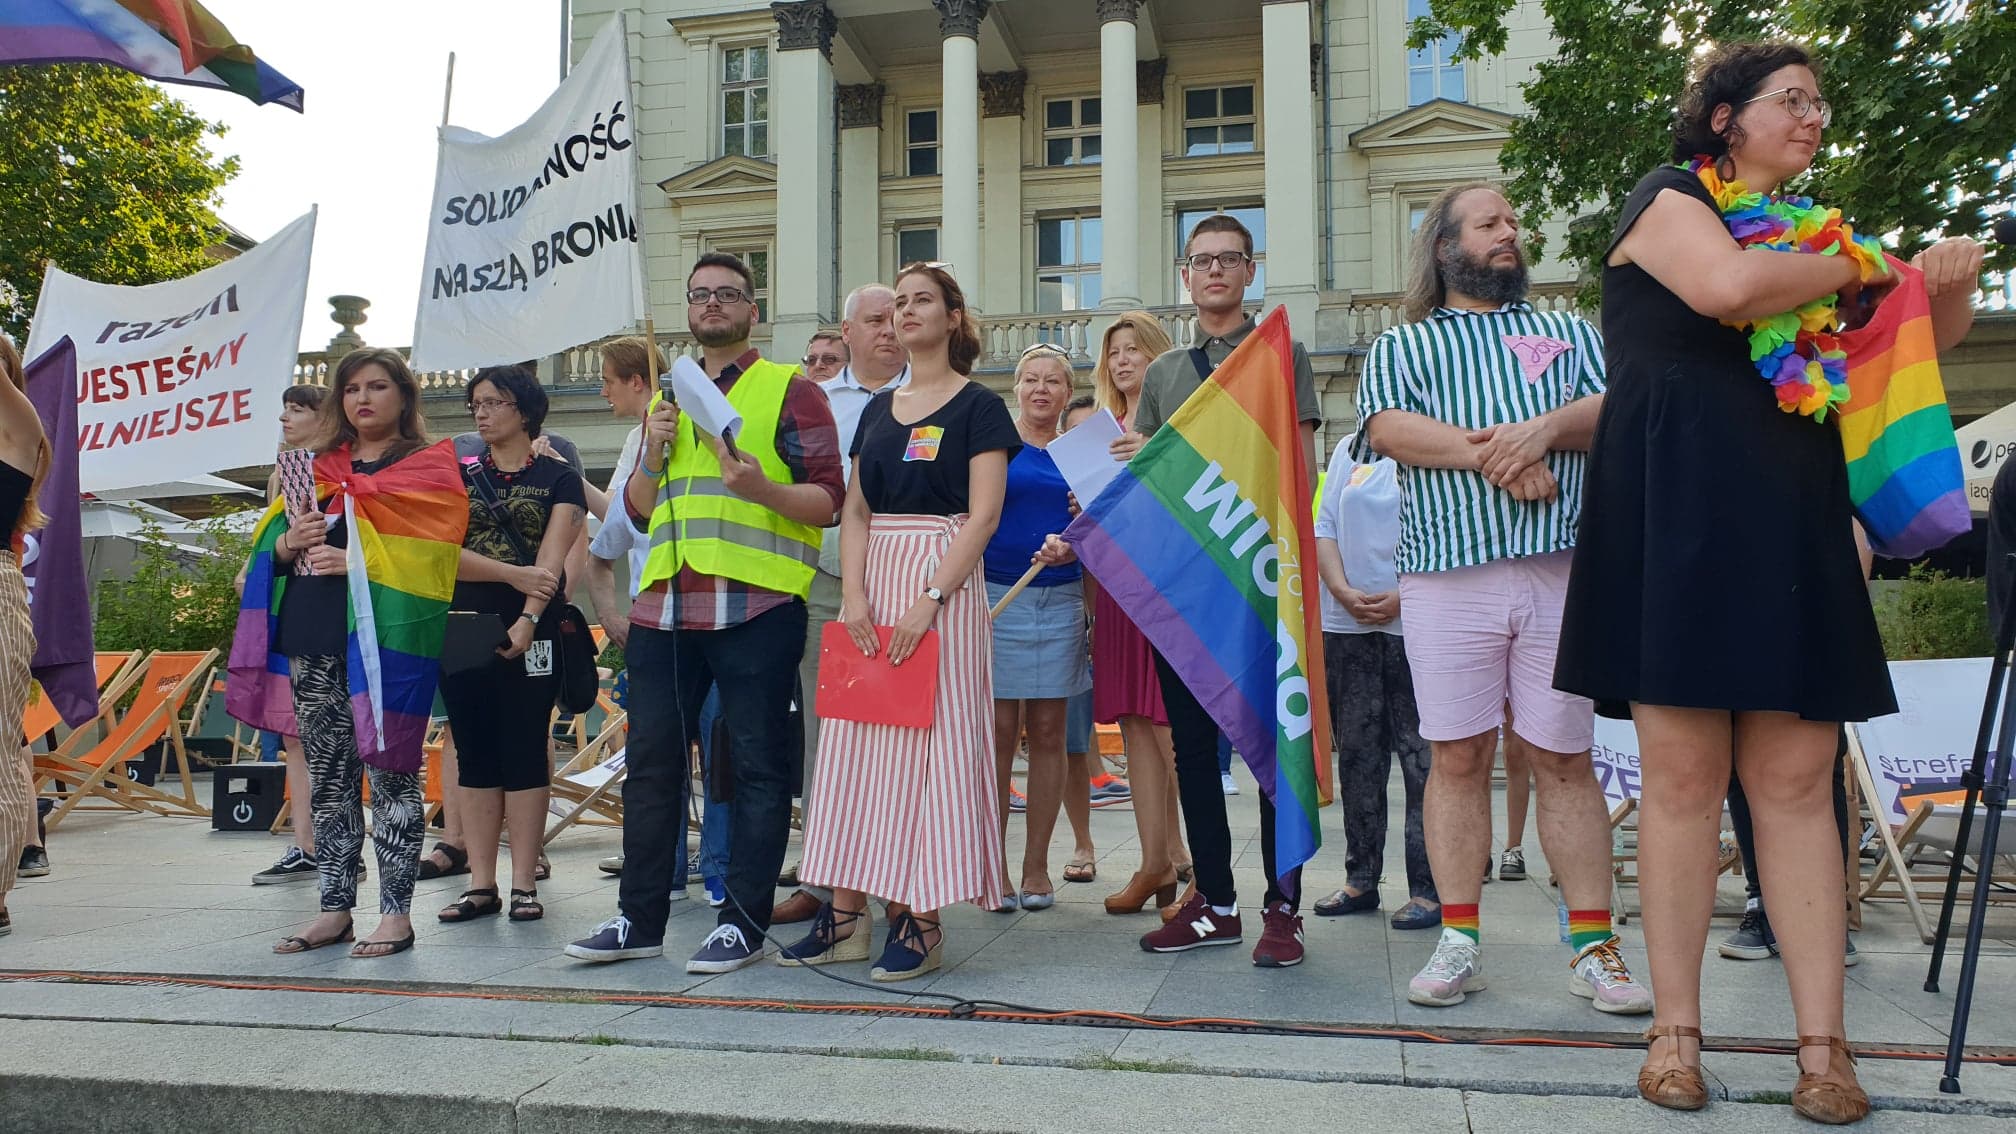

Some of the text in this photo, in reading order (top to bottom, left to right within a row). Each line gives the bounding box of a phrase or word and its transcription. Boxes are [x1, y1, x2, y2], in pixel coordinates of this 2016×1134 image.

[443, 101, 632, 226] SOLIDNOŚĆ
[432, 253, 528, 300] NASZĄ
[95, 283, 240, 344] razem
[77, 332, 248, 404] JESTEŚMY
[78, 387, 252, 452] ILNIEJSZE
[1995, 441, 2016, 463] pe
